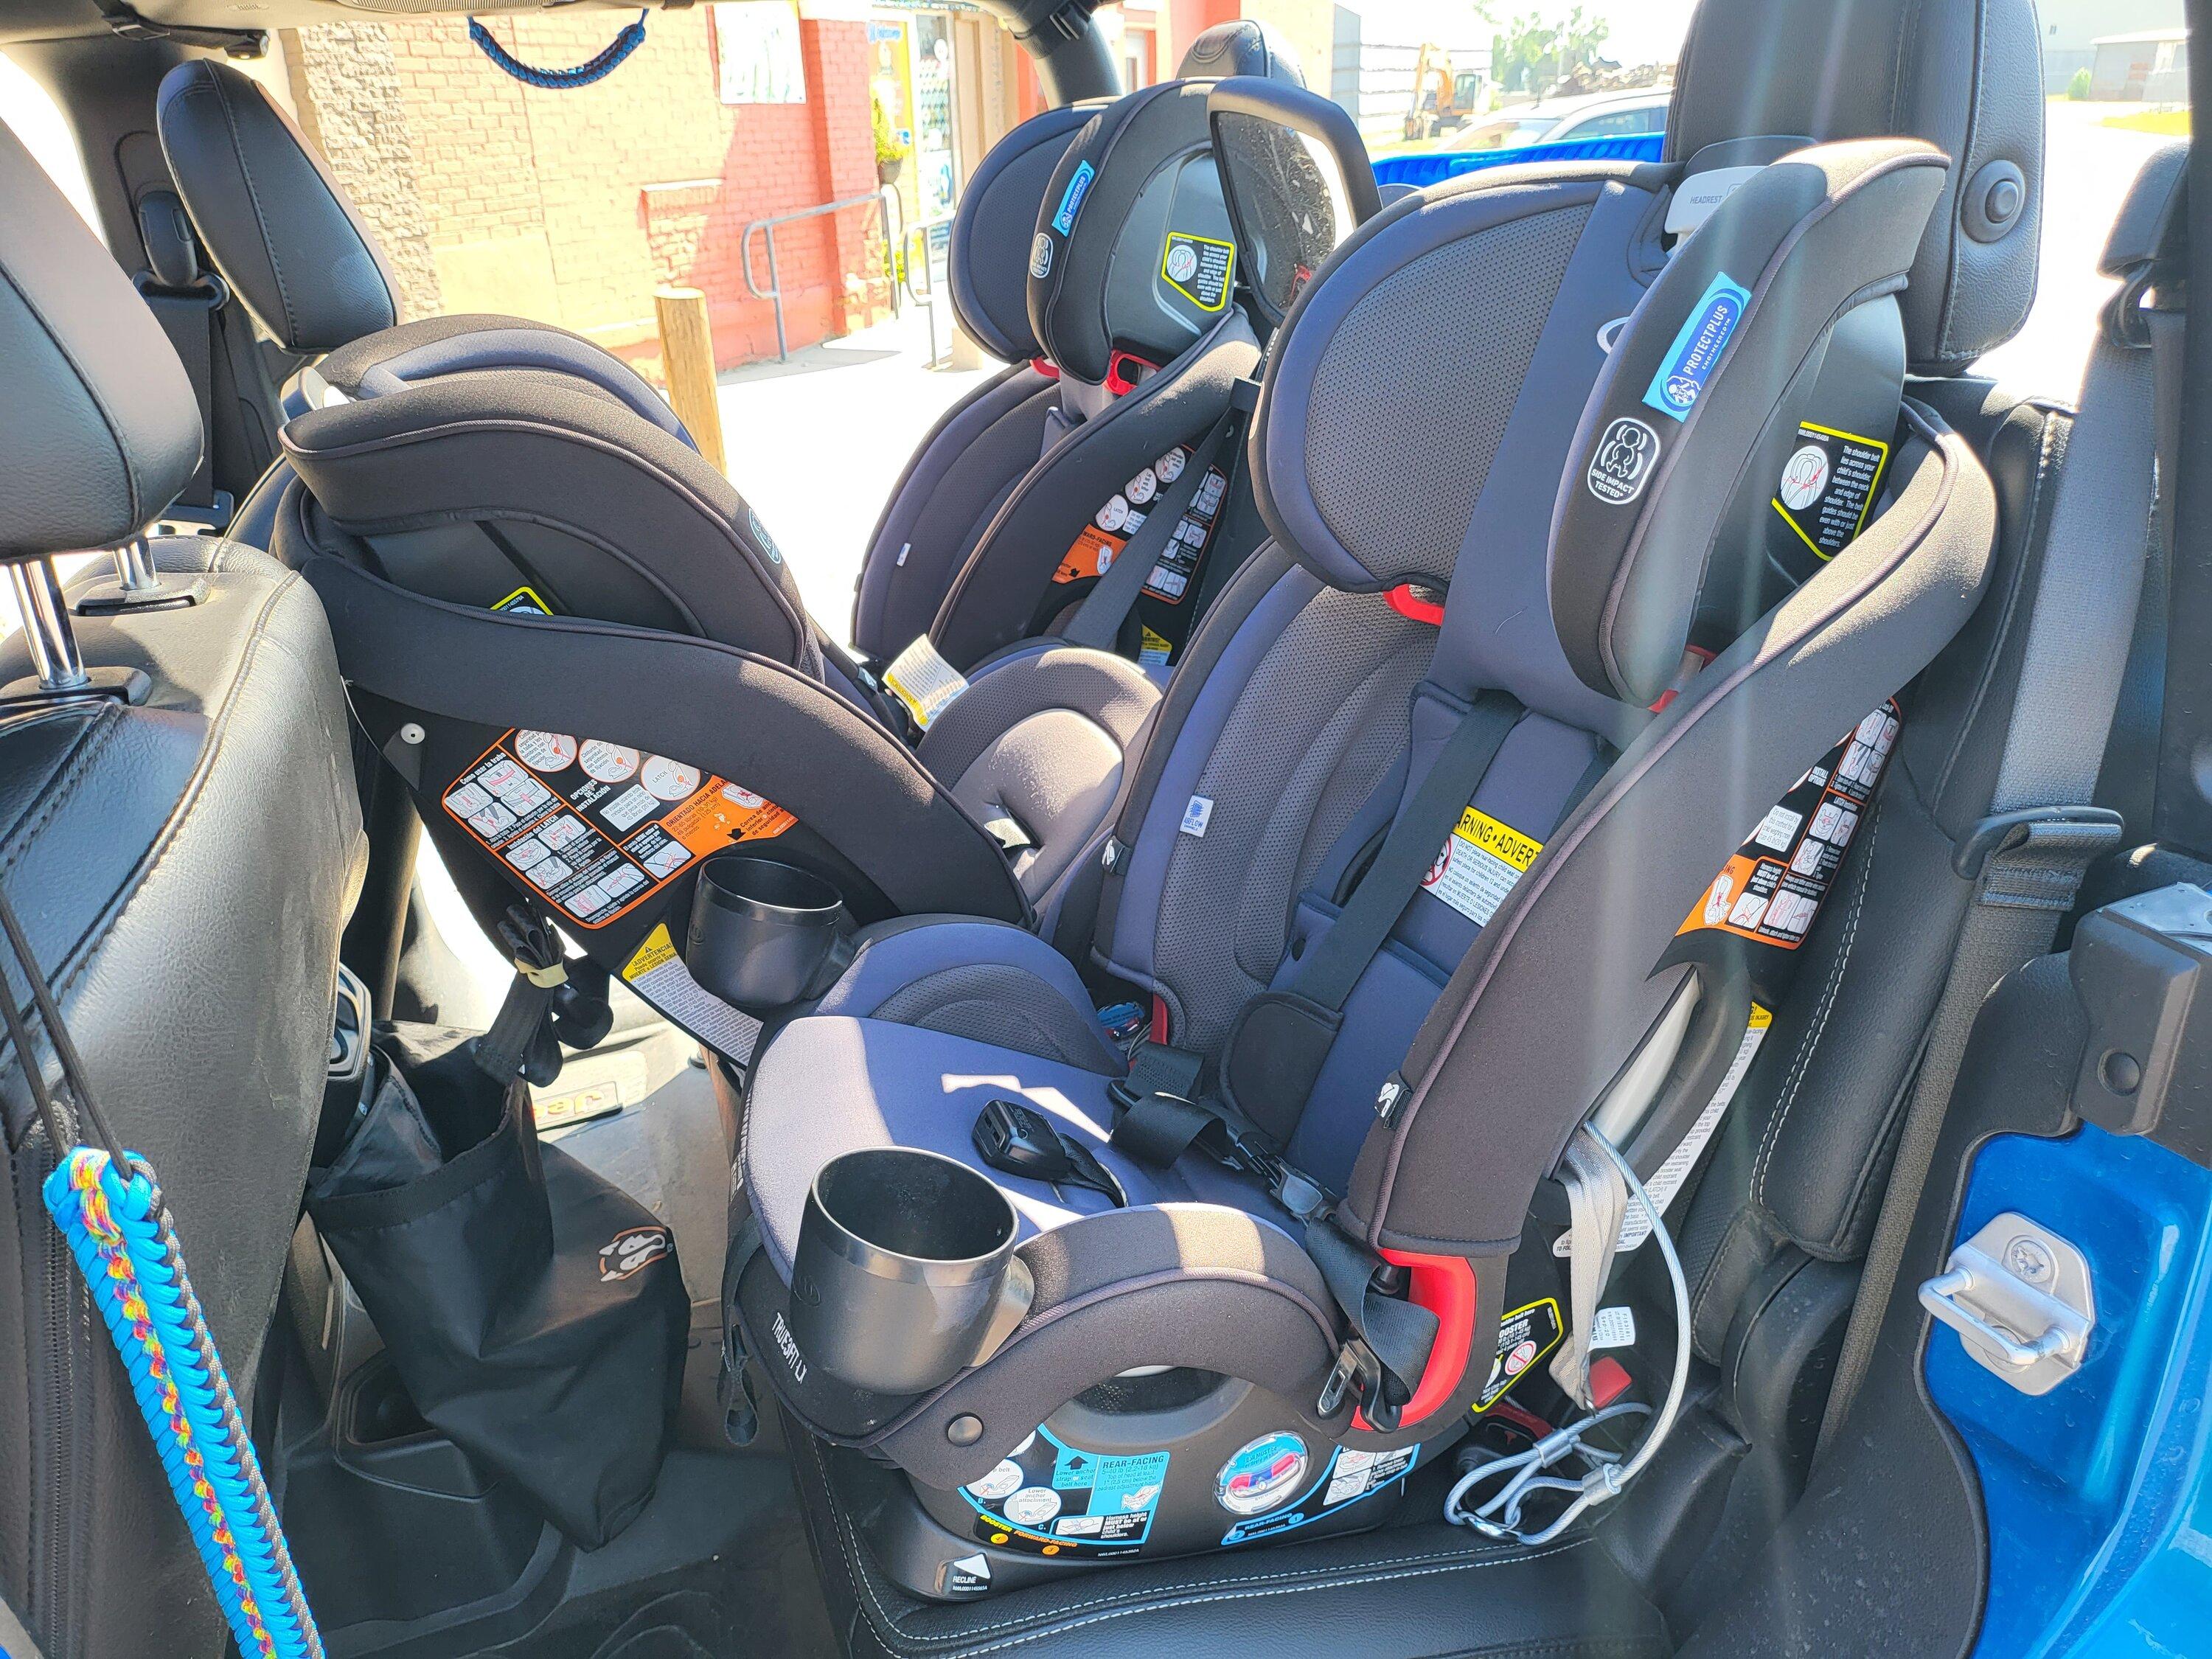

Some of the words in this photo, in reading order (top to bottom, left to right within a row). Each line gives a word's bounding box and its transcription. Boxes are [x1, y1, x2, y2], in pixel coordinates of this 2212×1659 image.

[1690, 195, 1722, 204] HEADREST
[1683, 305, 1728, 375] PROTECTPLUS
[1843, 445, 1851, 454] The
[1851, 448, 1871, 459] shoulder
[1870, 453, 1879, 462] belt
[1840, 456, 1848, 465] lies
[1848, 459, 1864, 469] across
[1863, 463, 1875, 471] your
[1592, 468, 1607, 482] SIDE
[1606, 476, 1635, 495] IMPACT
[1832, 476, 1850, 486] between
[1850, 480, 1858, 488] the
[1843, 490, 1854, 498] edge
[1846, 500, 1854, 508] The
[1854, 502, 1863, 510] belt
[1821, 507, 1837, 515] guides
[1837, 509, 1852, 518] should
[1844, 521, 1854, 530] just
[1822, 527, 1836, 535] above
[1836, 529, 1844, 538] the
[518, 734, 536, 747] seguridad
[526, 751, 541, 762] sistema
[583, 748, 602, 763] seguridad
[593, 752, 608, 764] sistema
[459, 773, 476, 784] Como
[474, 765, 487, 775] usar
[490, 752, 506, 763] traba
[594, 759, 609, 770] fijación
[652, 771, 667, 782] LATCH
[1812, 766, 1828, 779] INSTALL
[1808, 773, 1826, 786] OPTIONS
[570, 779, 597, 799] OPCIONES
[583, 790, 594, 798] DE
[576, 785, 611, 811] INSTALACIÓN
[627, 804, 638, 813] pesa
[666, 804, 695, 827] ORIENTADO
[693, 793, 710, 806] HACIA
[684, 813, 697, 822] libras
[740, 814, 757, 827] Correa
[745, 817, 762, 831] inferior
[758, 811, 779, 830] seguridad
[507, 832, 534, 849] Instalación
[531, 825, 542, 833] del
[540, 814, 558, 828] LATCH
[1470, 849, 1481, 857] place
[1498, 863, 1507, 872] child
[1452, 857, 1462, 865] safest
[1475, 871, 1489, 881] children
[1500, 886, 1509, 894] unde
[634, 963, 647, 971] Puede
[647, 955, 661, 964] ocurrir
[629, 968, 646, 979] MUERTE
[1498, 1318, 1528, 1338] OOSTER
[1256, 1447, 1270, 1459] MUST
[1102, 1455, 1164, 1470] REAR-FACING
[1125, 1465, 1147, 1473] (2.2-18
[979, 1514, 1013, 1532] BOOSTER
[1245, 1513, 1293, 1531] REAR-FACING
[1014, 1530, 1078, 1548] FORWARD-FACING
